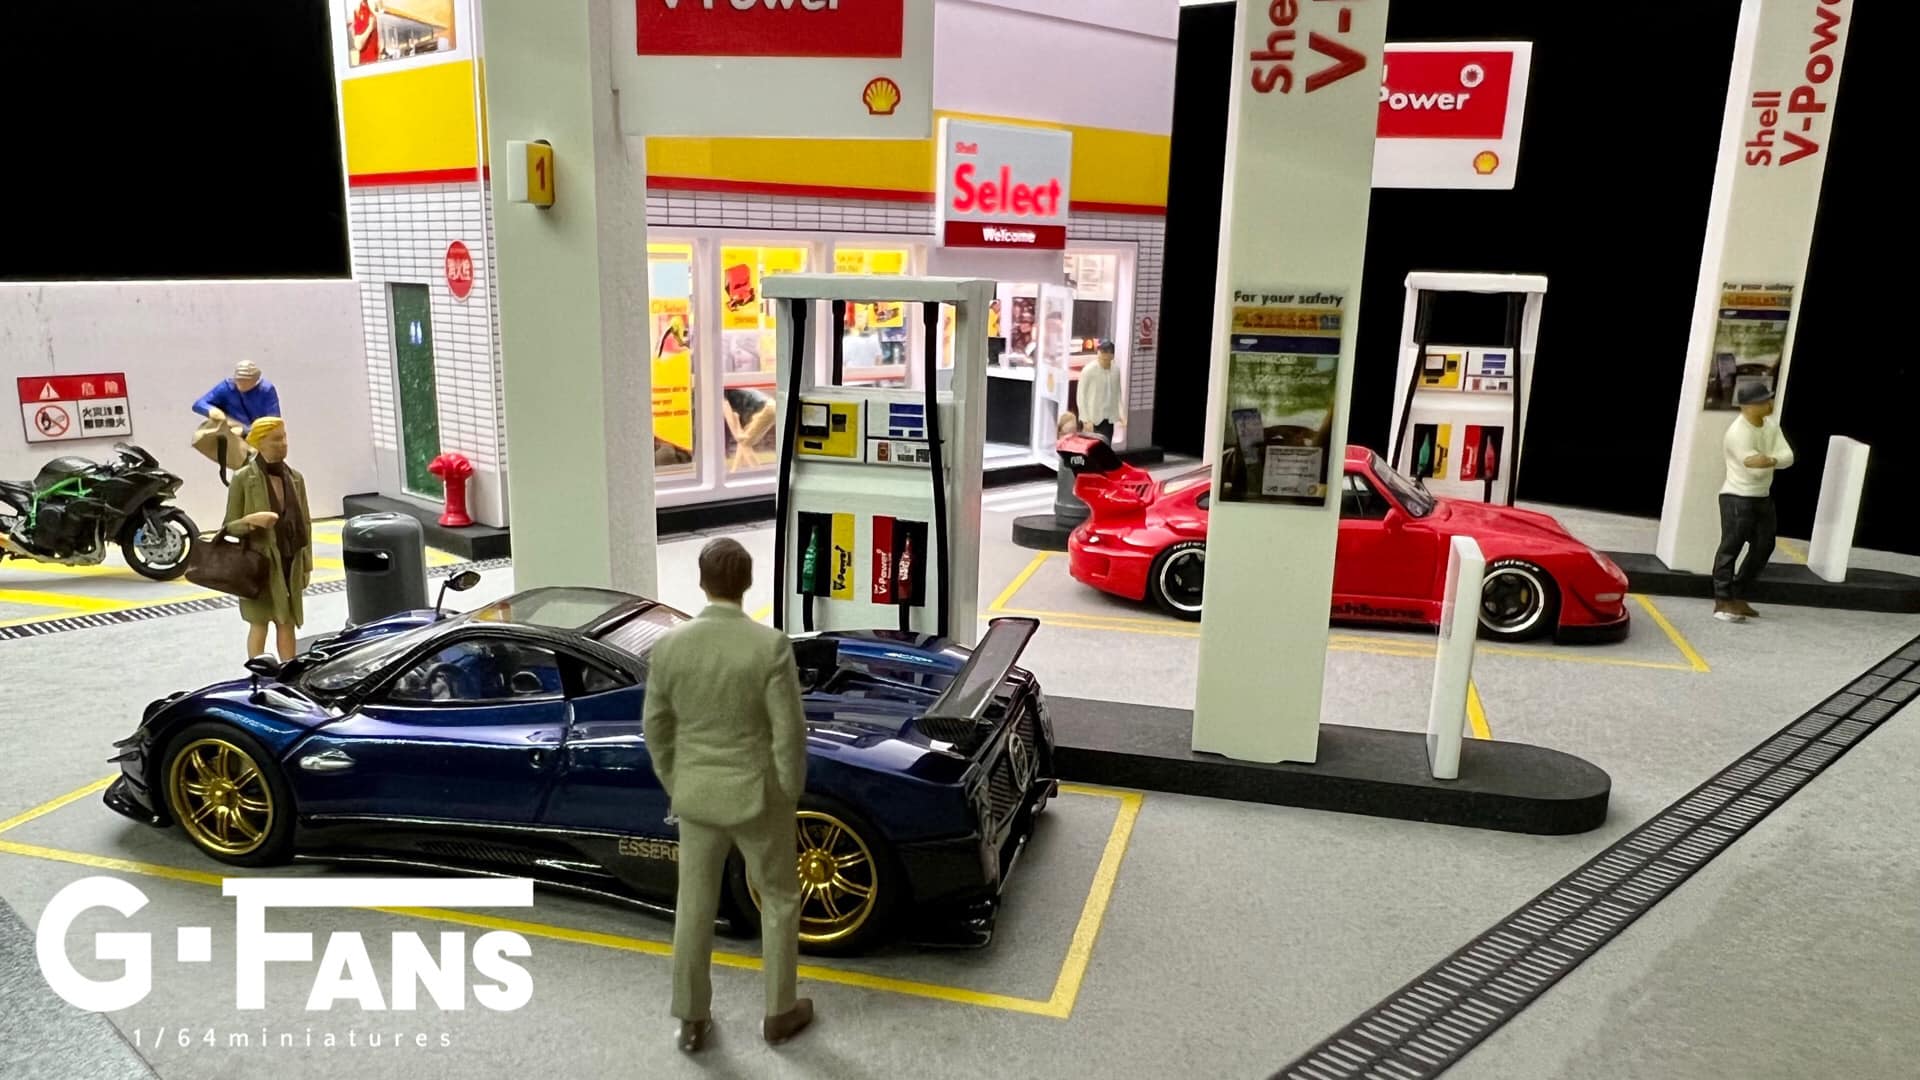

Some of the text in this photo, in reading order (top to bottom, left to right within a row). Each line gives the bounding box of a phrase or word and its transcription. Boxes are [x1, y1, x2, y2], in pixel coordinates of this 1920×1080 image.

[1305, 0, 1367, 94] V-
[1778, 0, 1842, 166] V-Pow
[1745, 91, 1782, 166] Shell
[535, 156, 546, 191] 1
[953, 162, 1061, 216] Select
[982, 227, 1036, 243] Welcome
[1234, 291, 1344, 308] For your safety
